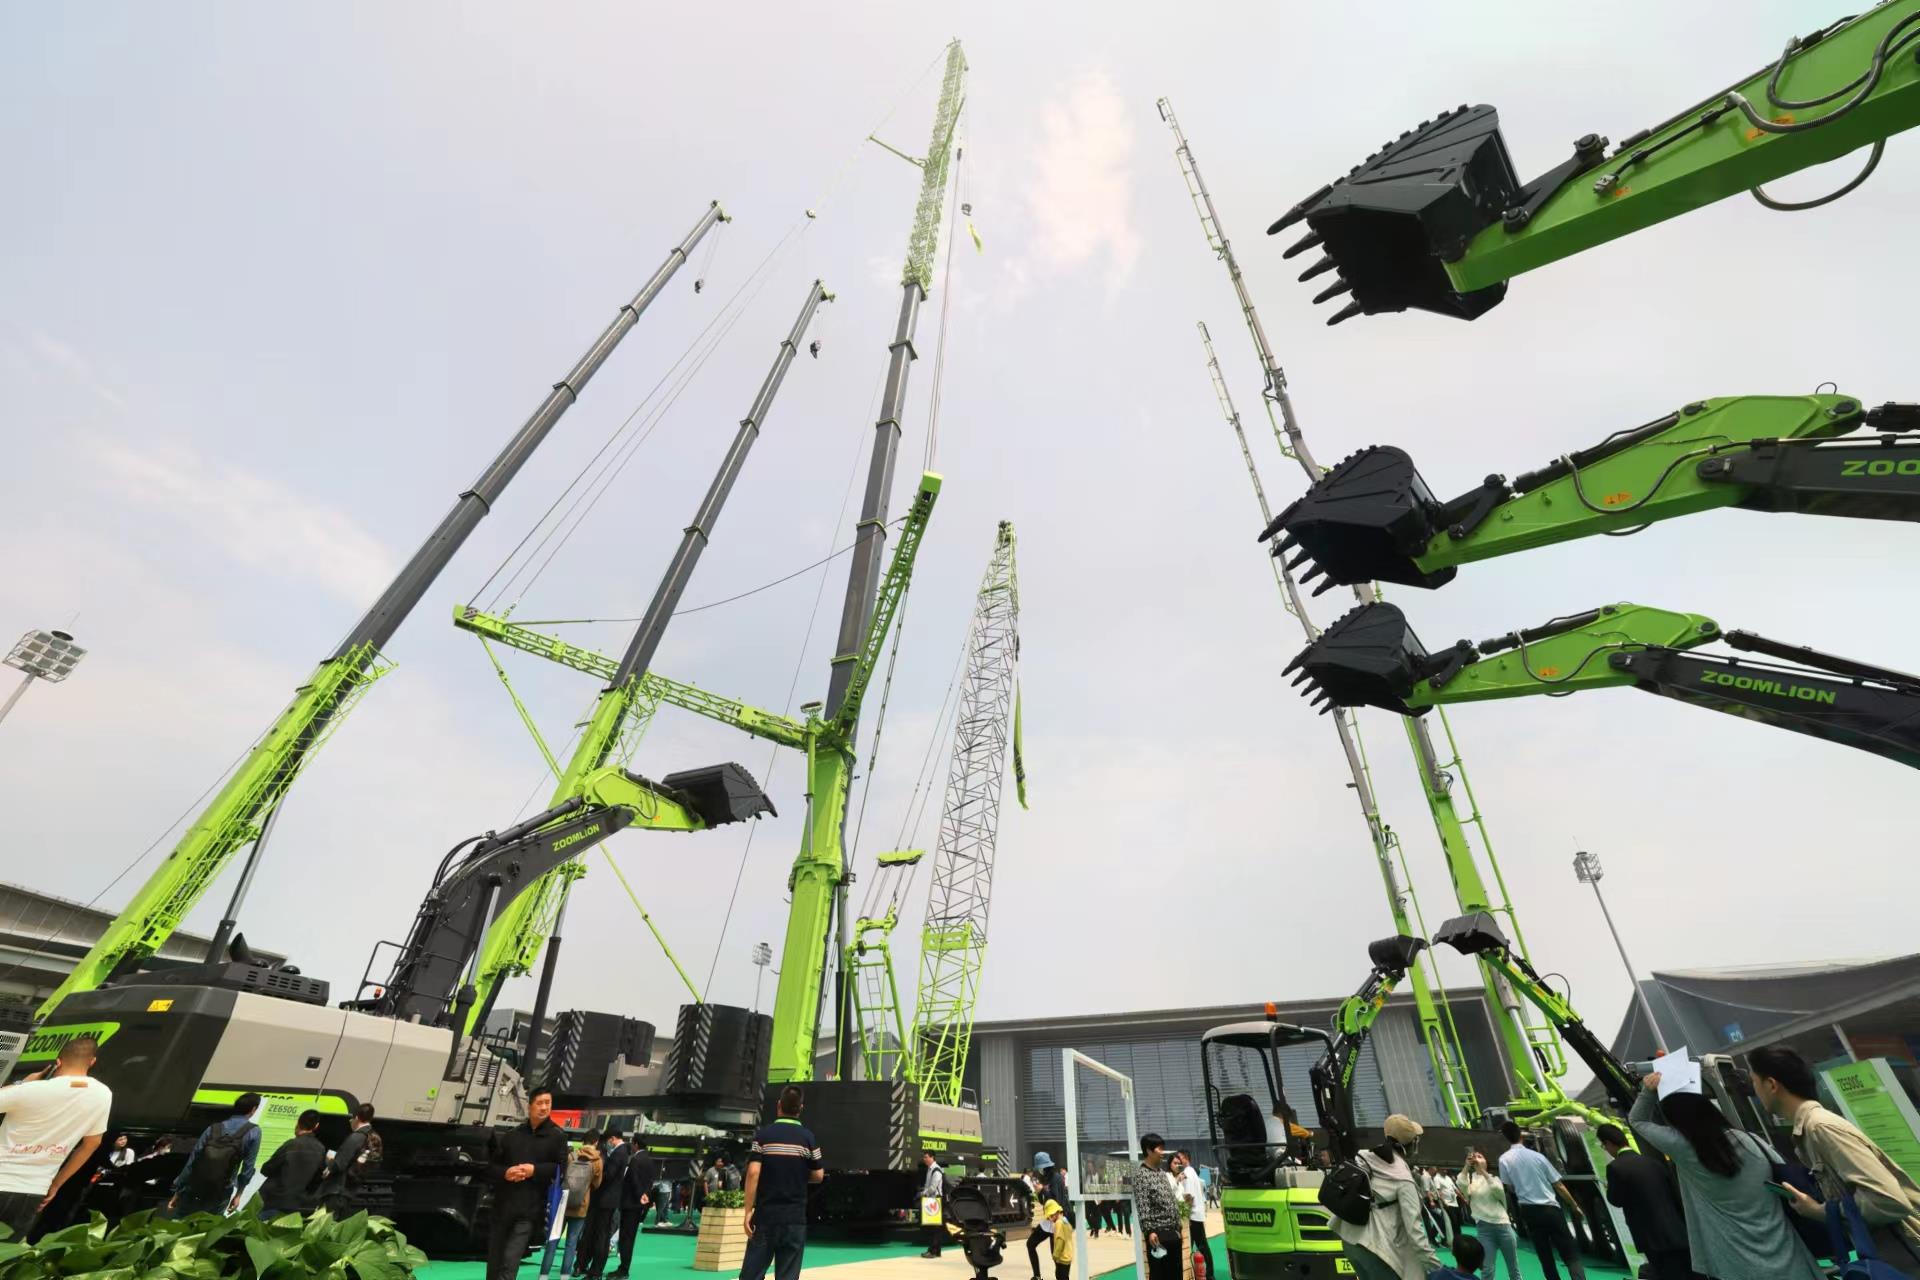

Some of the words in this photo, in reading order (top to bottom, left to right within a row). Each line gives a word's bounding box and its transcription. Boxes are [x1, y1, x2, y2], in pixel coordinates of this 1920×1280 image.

[1700, 669, 1837, 704] ZOOMLION
[552, 822, 600, 852] ZOOMLION
[268, 1104, 298, 1114] ZE650G
[1226, 1211, 1273, 1223] ZOOMLION
